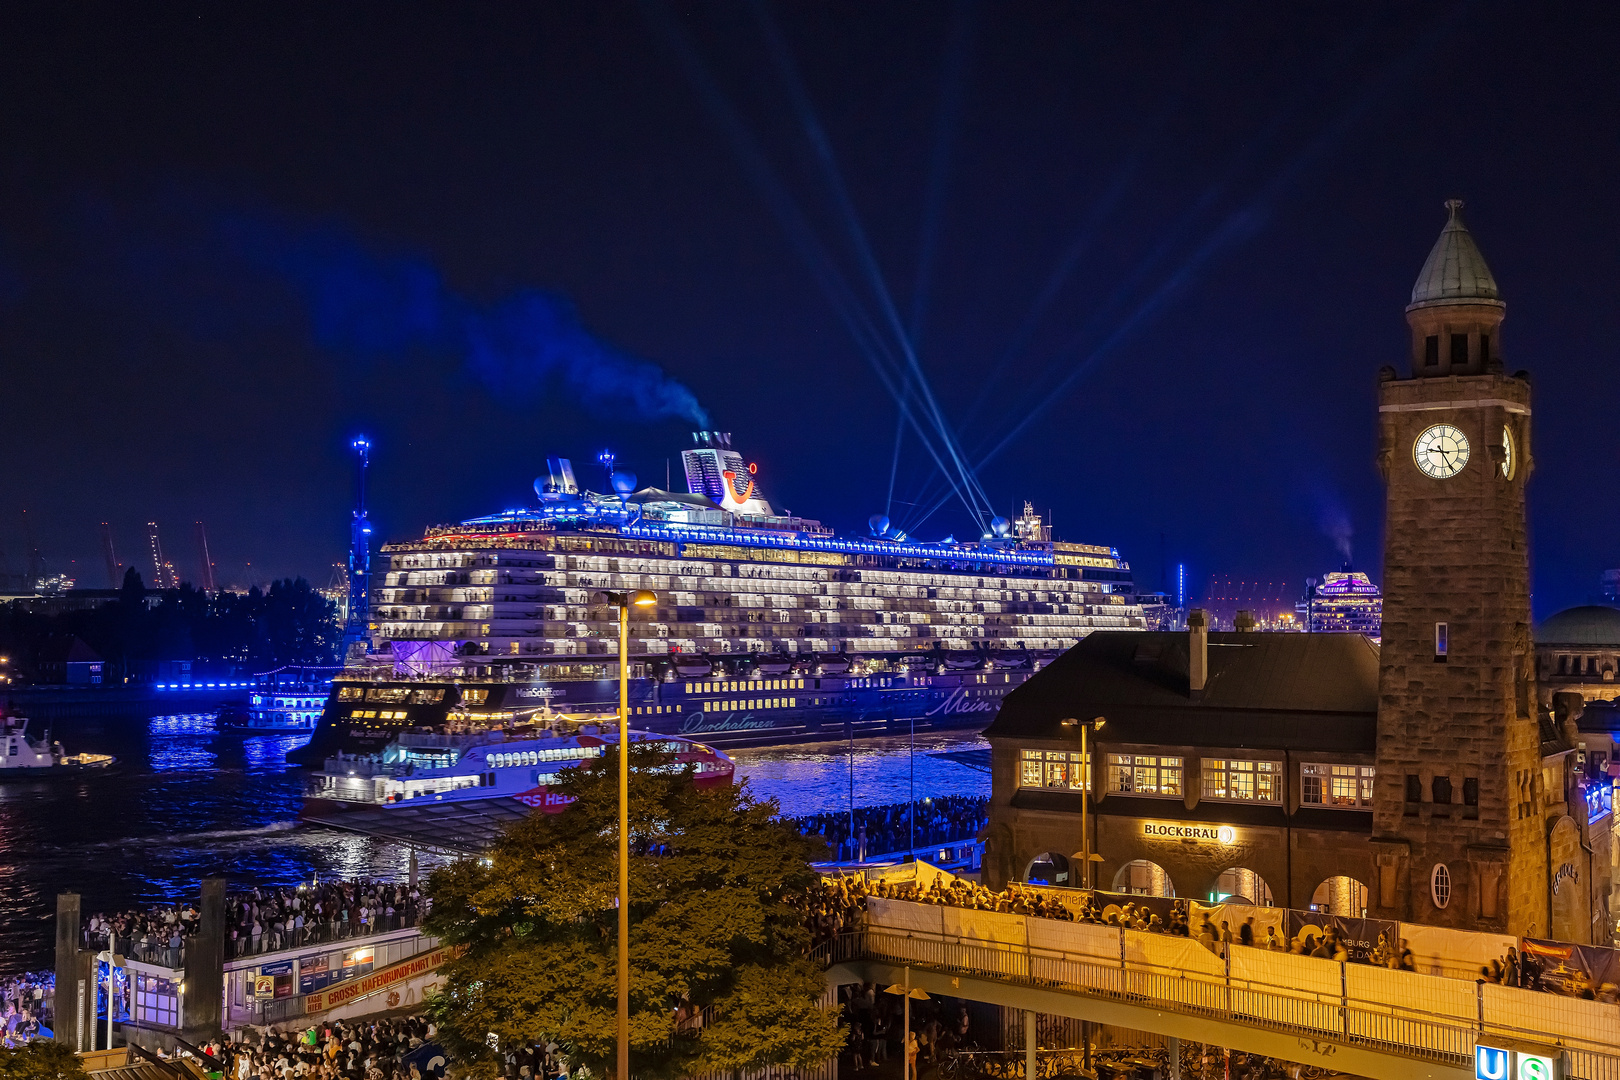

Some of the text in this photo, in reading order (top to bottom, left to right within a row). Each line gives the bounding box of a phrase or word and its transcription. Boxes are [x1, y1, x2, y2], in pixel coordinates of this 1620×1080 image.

[925, 686, 992, 716] Mein
[678, 711, 776, 734] Durchatmen
[513, 793, 576, 807] RS HEL
[1144, 824, 1218, 839] BLOCKBRÄU
[328, 983, 360, 1005] GROSSE
[361, 957, 429, 993] HAFENRUNDFAHRT
[307, 994, 323, 1004] KASSE
[307, 1002, 323, 1013] HIER
[1480, 1048, 1504, 1080] U
